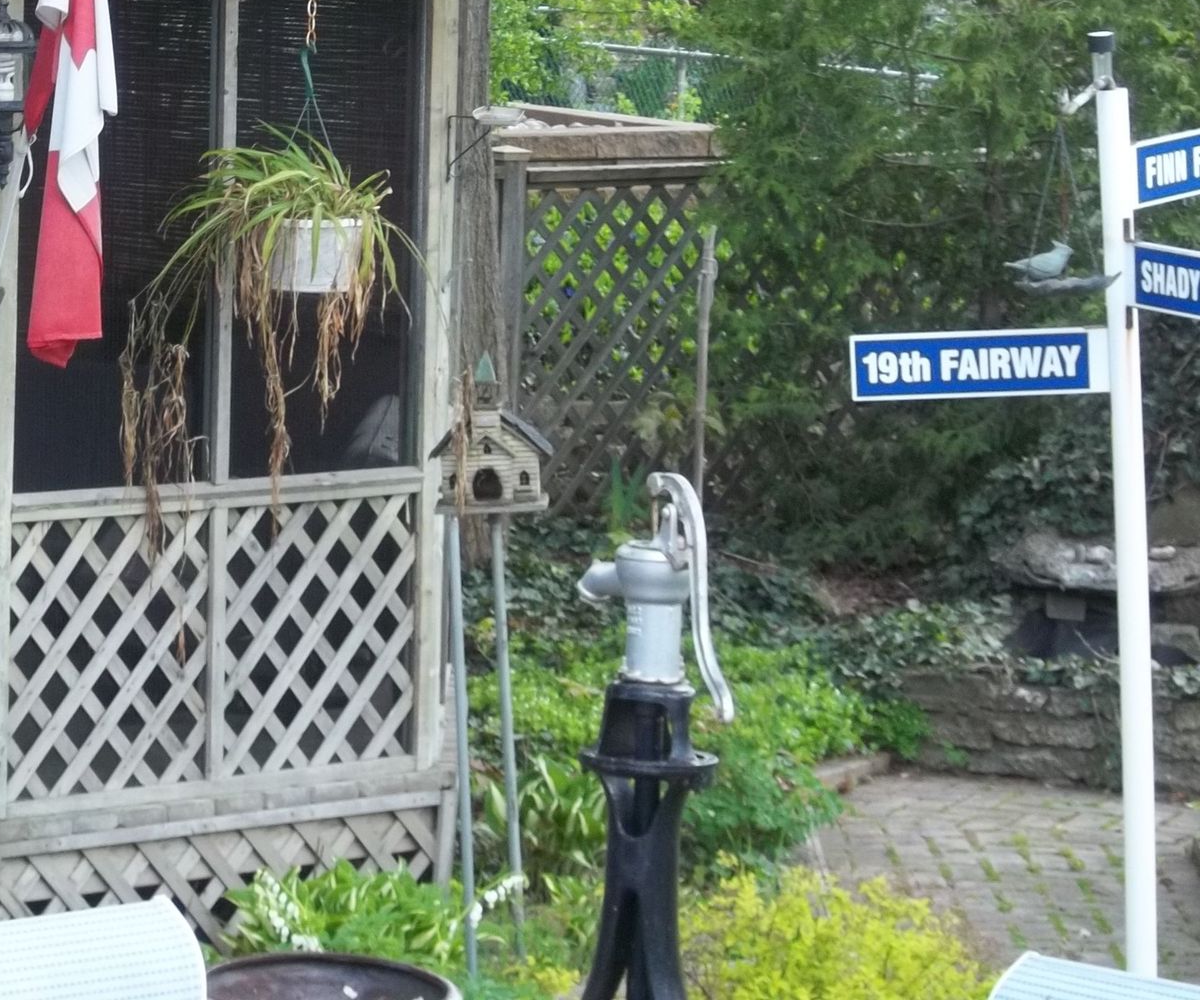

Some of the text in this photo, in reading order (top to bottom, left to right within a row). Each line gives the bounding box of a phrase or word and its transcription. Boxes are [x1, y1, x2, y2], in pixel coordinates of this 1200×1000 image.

[1145, 149, 1188, 189] FINN
[1141, 259, 1200, 302] SHADY
[861, 345, 1081, 384] 19th FAIRWAY
